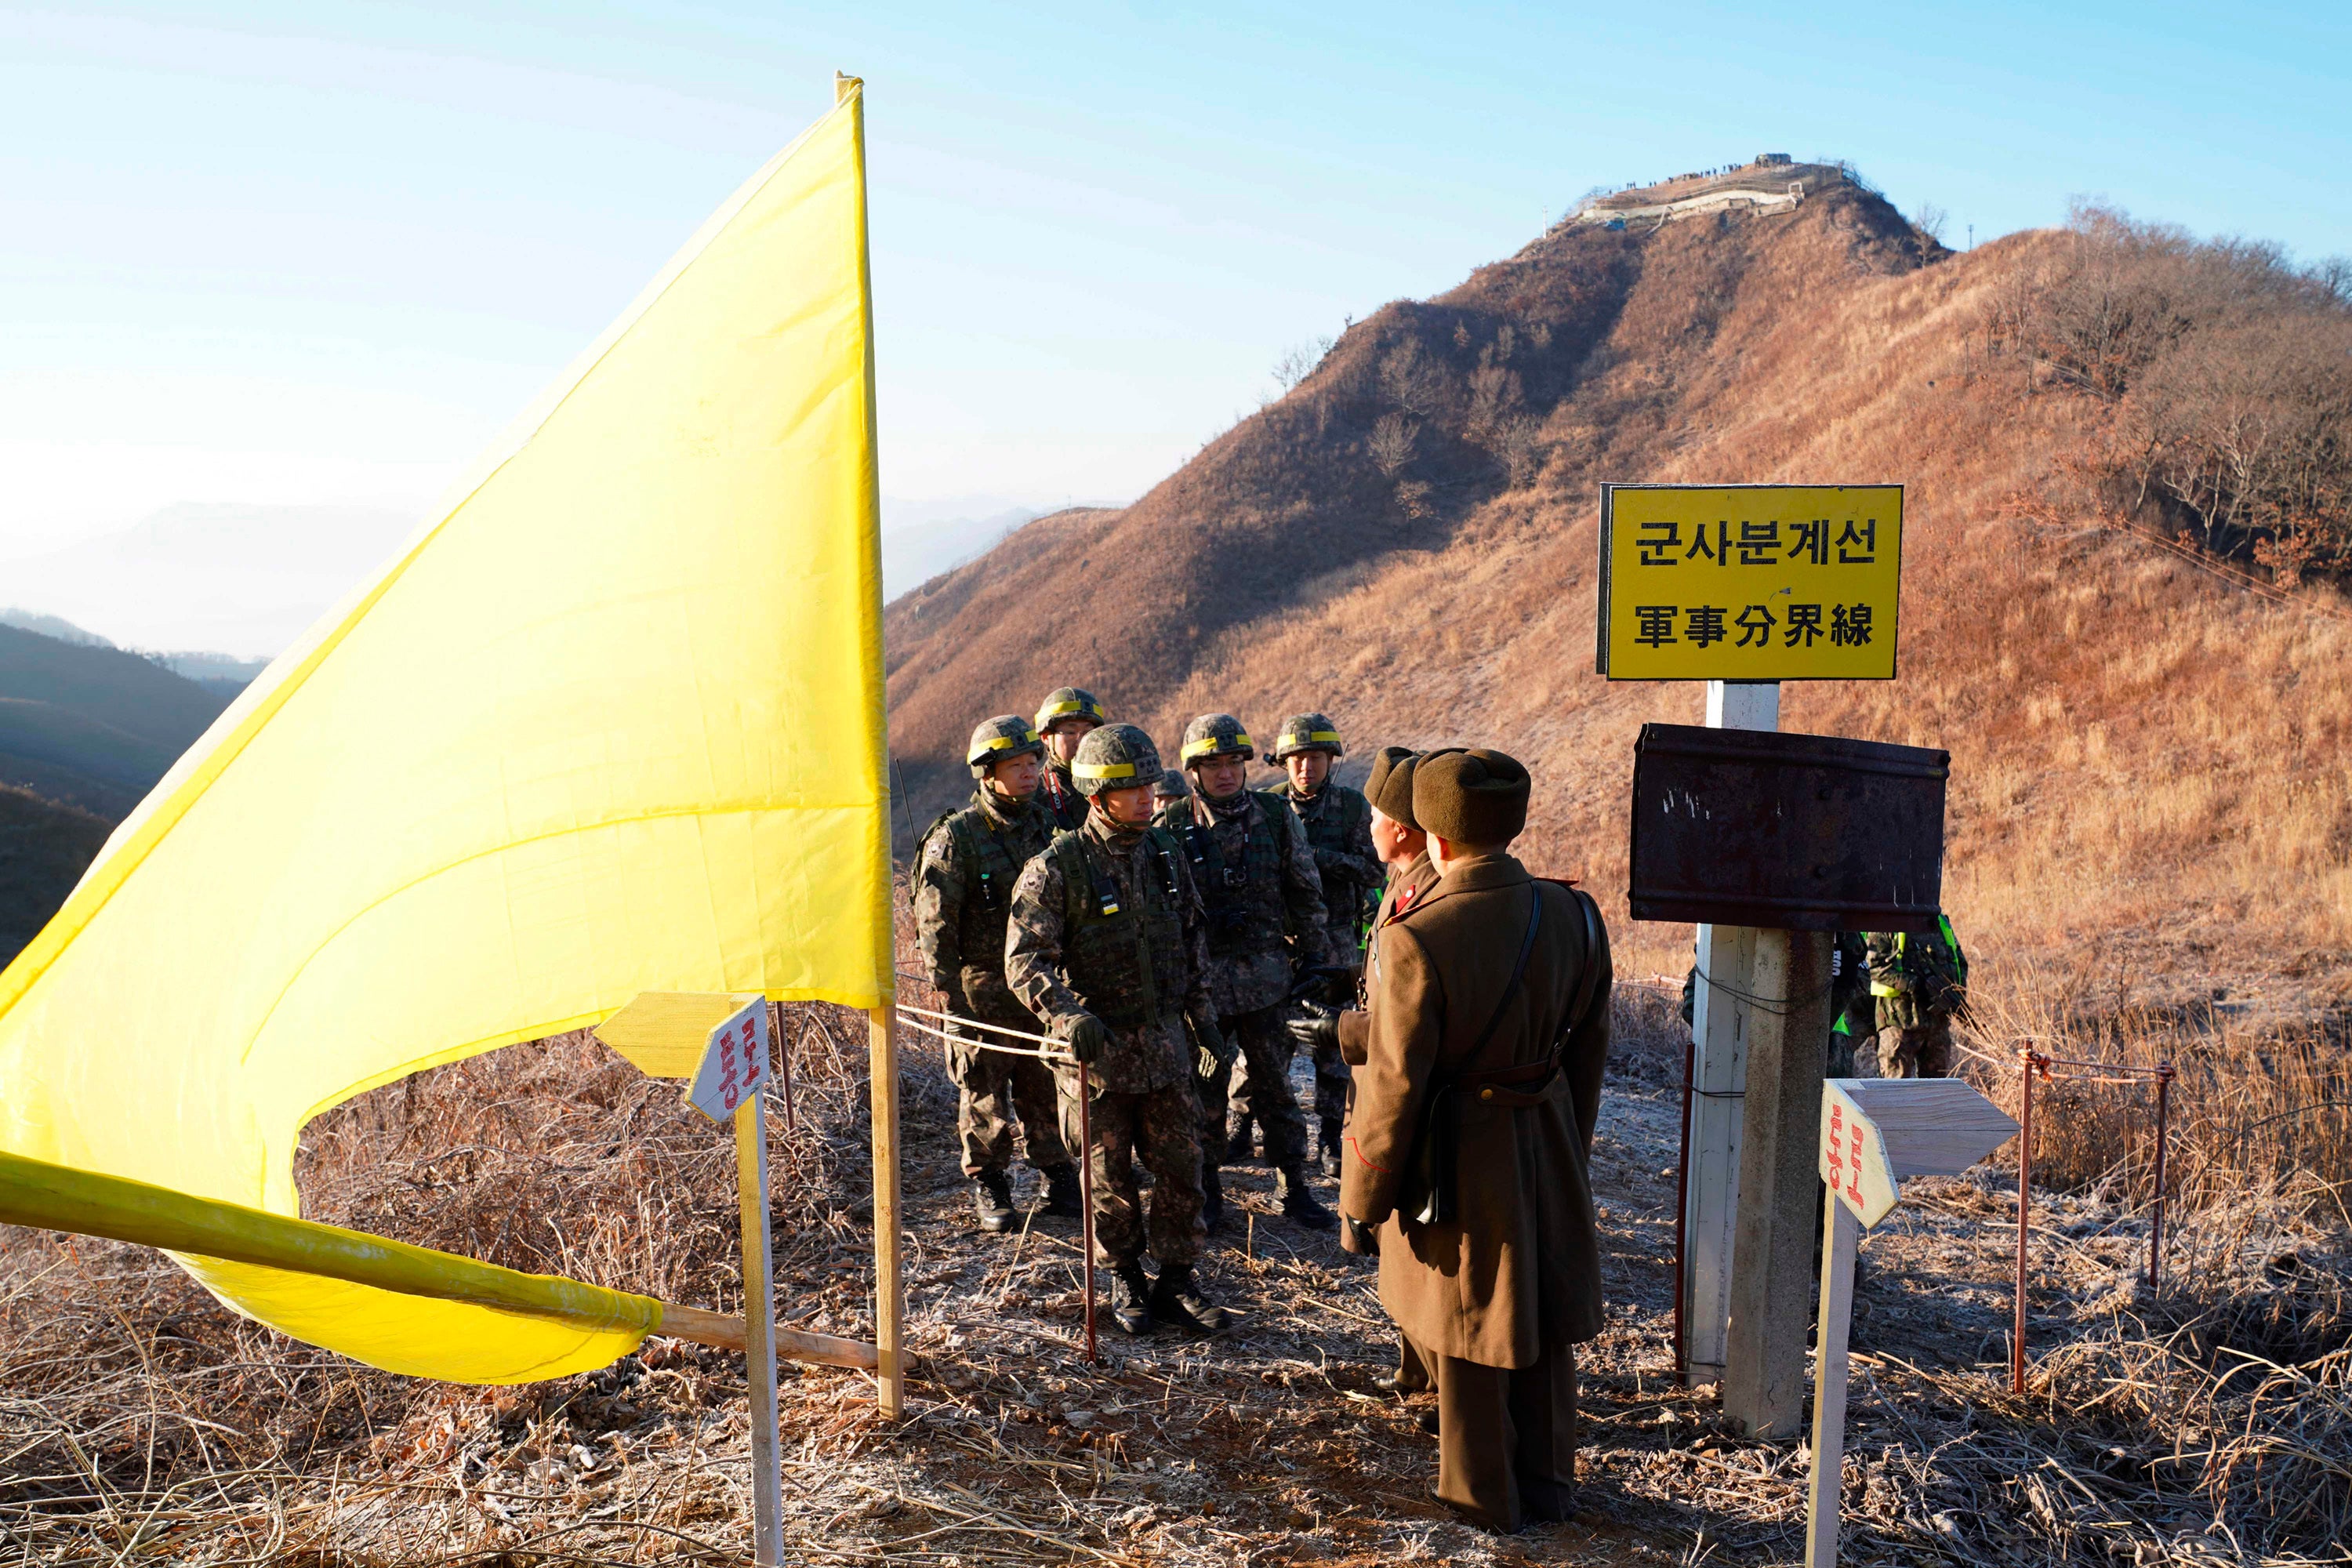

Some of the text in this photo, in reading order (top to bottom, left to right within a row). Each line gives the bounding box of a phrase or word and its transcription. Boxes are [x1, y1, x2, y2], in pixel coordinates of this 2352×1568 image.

[1635, 519, 1876, 566] 군사분계선
[1634, 602, 1873, 649] 軍事分界線
[718, 1017, 760, 1110] 통로
[1826, 1104, 1864, 1210] 통로
